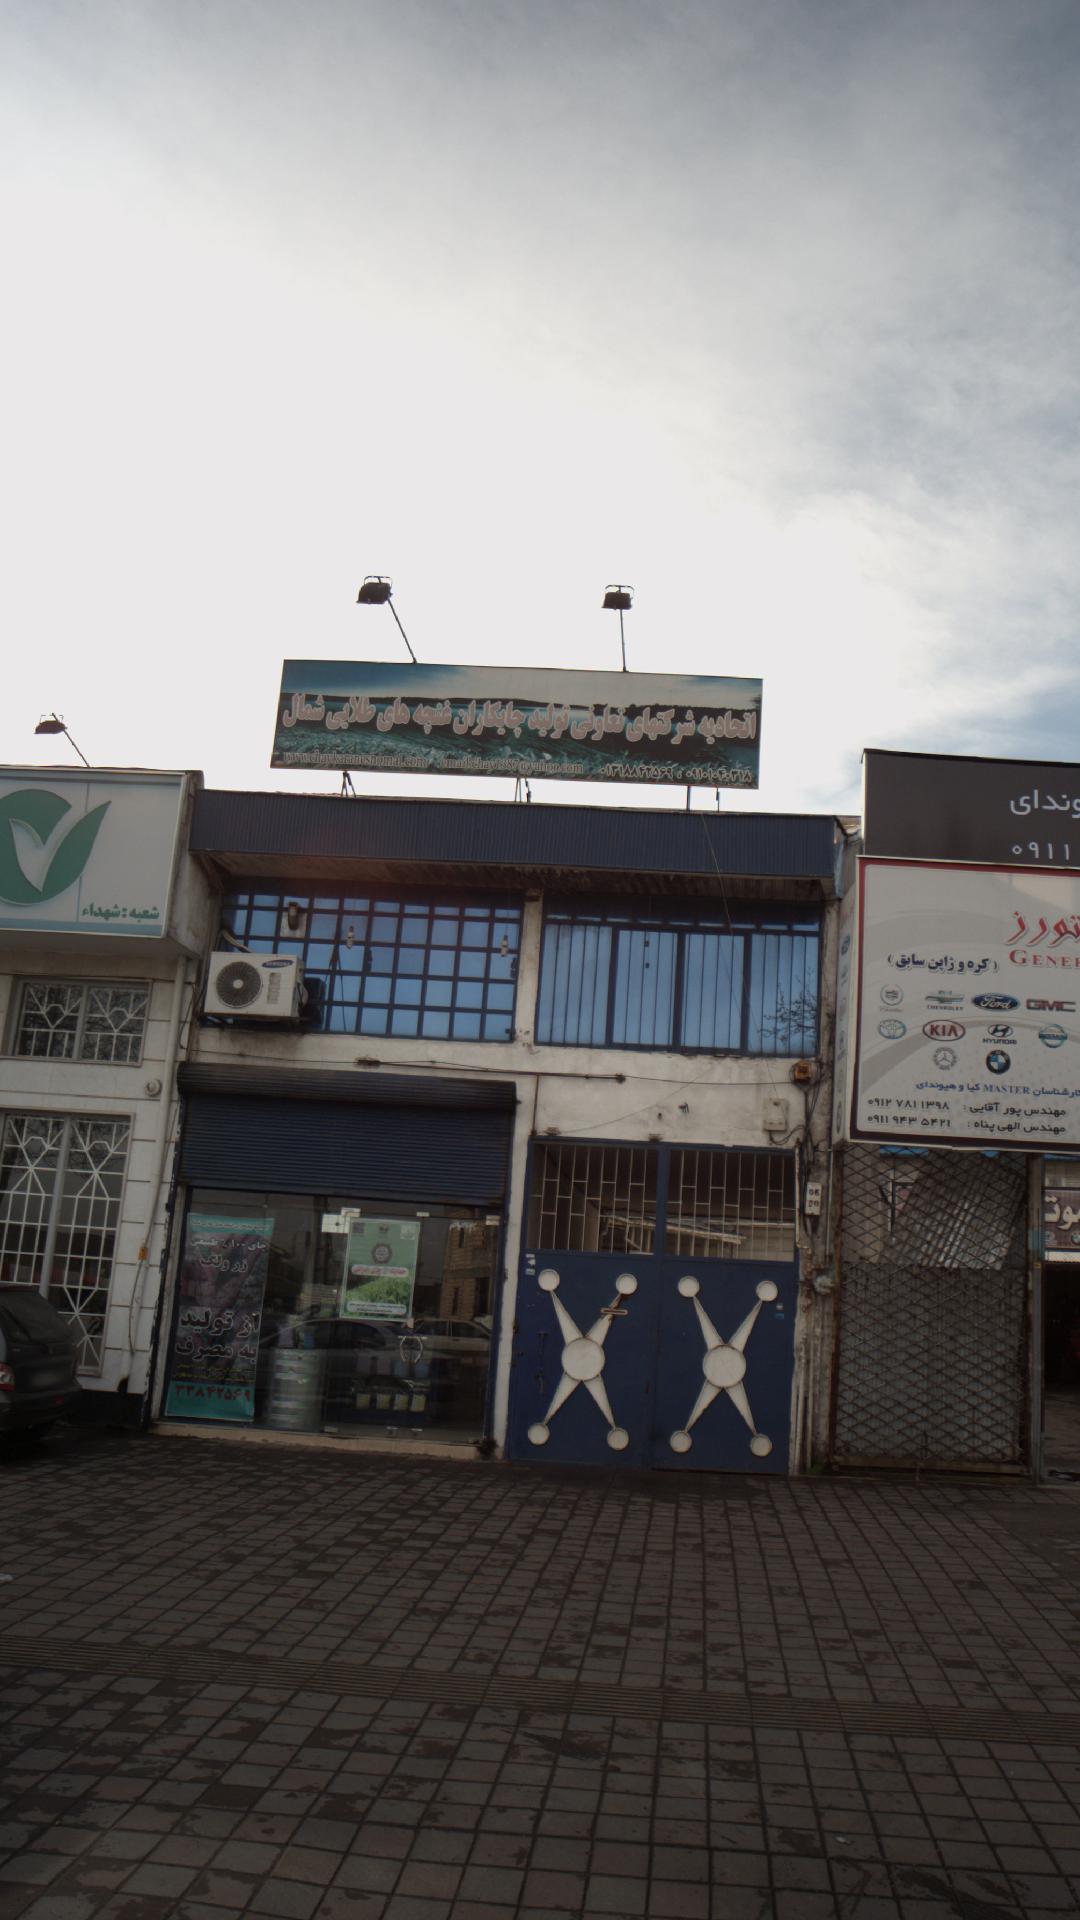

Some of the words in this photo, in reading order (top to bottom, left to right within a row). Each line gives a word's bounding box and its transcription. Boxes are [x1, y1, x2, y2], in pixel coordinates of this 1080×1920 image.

[282, 692, 326, 727] شمال
[325, 696, 377, 731] طلایی
[376, 697, 411, 732] های
[412, 699, 452, 735] غنچه
[453, 699, 525, 739] چایکاران
[528, 702, 570, 739] تولید
[571, 703, 625, 741] تعاونی
[626, 707, 695, 744] شرکتهای
[698, 710, 757, 745] اتحادیه
[1012, 841, 1070, 861] ۰۹۱۱
[928, 956, 955, 972] ژاپن
[958, 960, 965, 972] و
[980, 996, 1011, 1009] Ford
[1026, 999, 1076, 1013] GMC
[930, 1024, 958, 1037] KIA
[915, 1081, 957, 1091] هیوندای
[967, 1083, 980, 1092] کیا
[983, 1084, 1030, 1095] MASTER
[867, 1097, 892, 1107] ۰۹۱۲
[896, 1099, 917, 1109] ۷۸۱
[921, 1100, 950, 1110] ۱۳۹۸
[969, 1102, 1001, 1114] آقایی
[1003, 1106, 1021, 1117] پور
[1023, 1107, 1066, 1118] مهندس
[867, 1114, 889, 1124] ۰۹۱۱
[892, 1115, 917, 1125] ۹۴۳
[974, 1119, 995, 1132] پناه
[997, 1121, 1021, 1132] الهی
[1023, 1124, 1066, 1135] مهندس
[180, 1308, 234, 1335] تولید
[236, 1311, 261, 1337] از
[175, 1336, 234, 1361] مصرف
[238, 1343, 258, 1364] به
